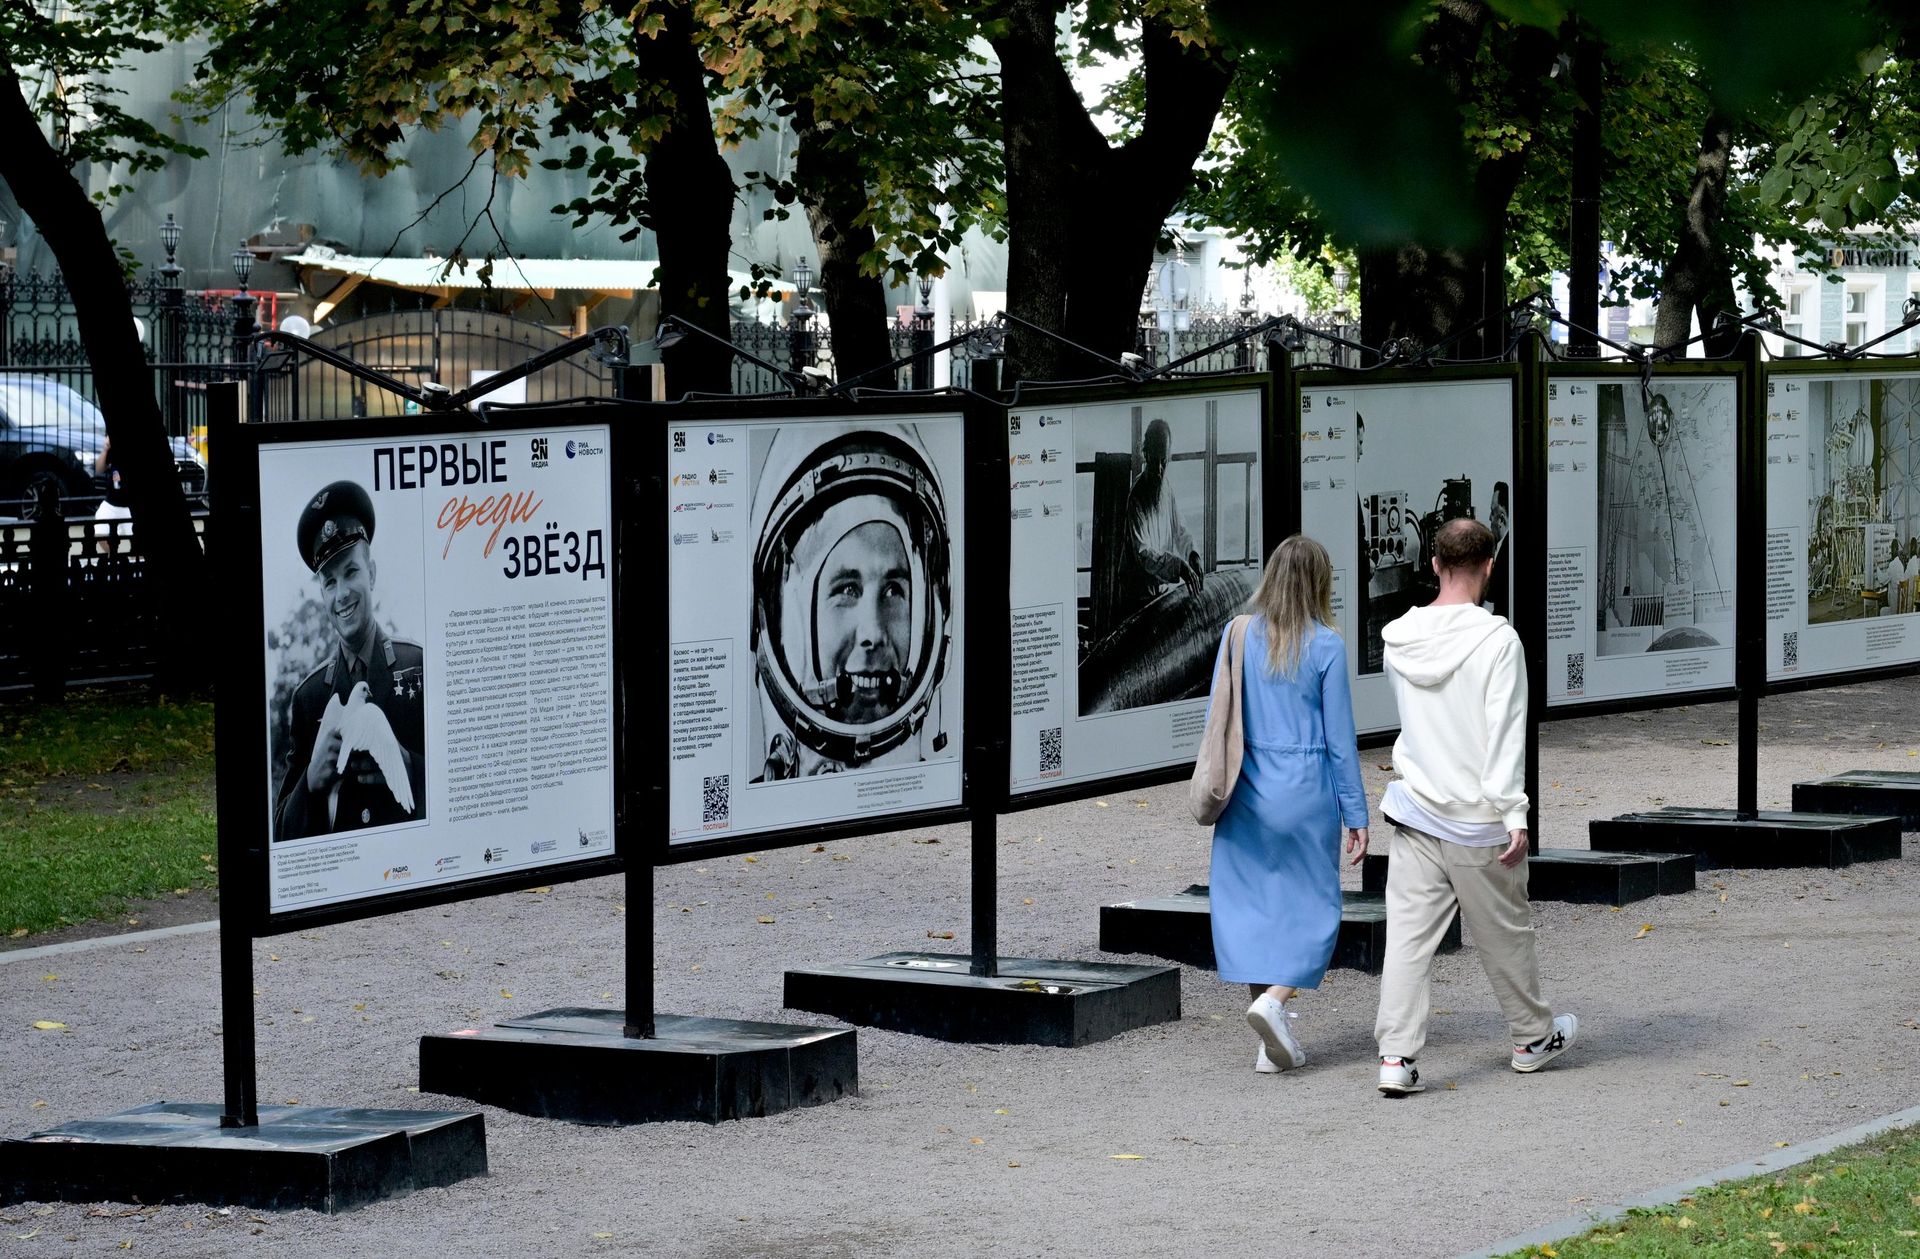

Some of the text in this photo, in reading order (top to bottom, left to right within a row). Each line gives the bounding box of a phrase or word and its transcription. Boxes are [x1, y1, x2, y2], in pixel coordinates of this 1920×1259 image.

[578, 448, 604, 456] НОВОСТИ
[373, 440, 508, 491] ПЕРВЫЕ
[531, 460, 549, 469] МЕДИА
[436, 490, 544, 560] среди
[503, 521, 606, 581] ЗВЁЗД
[703, 822, 729, 831] ПОСЛУШАЙ
[392, 865, 409, 873] РАДИО
